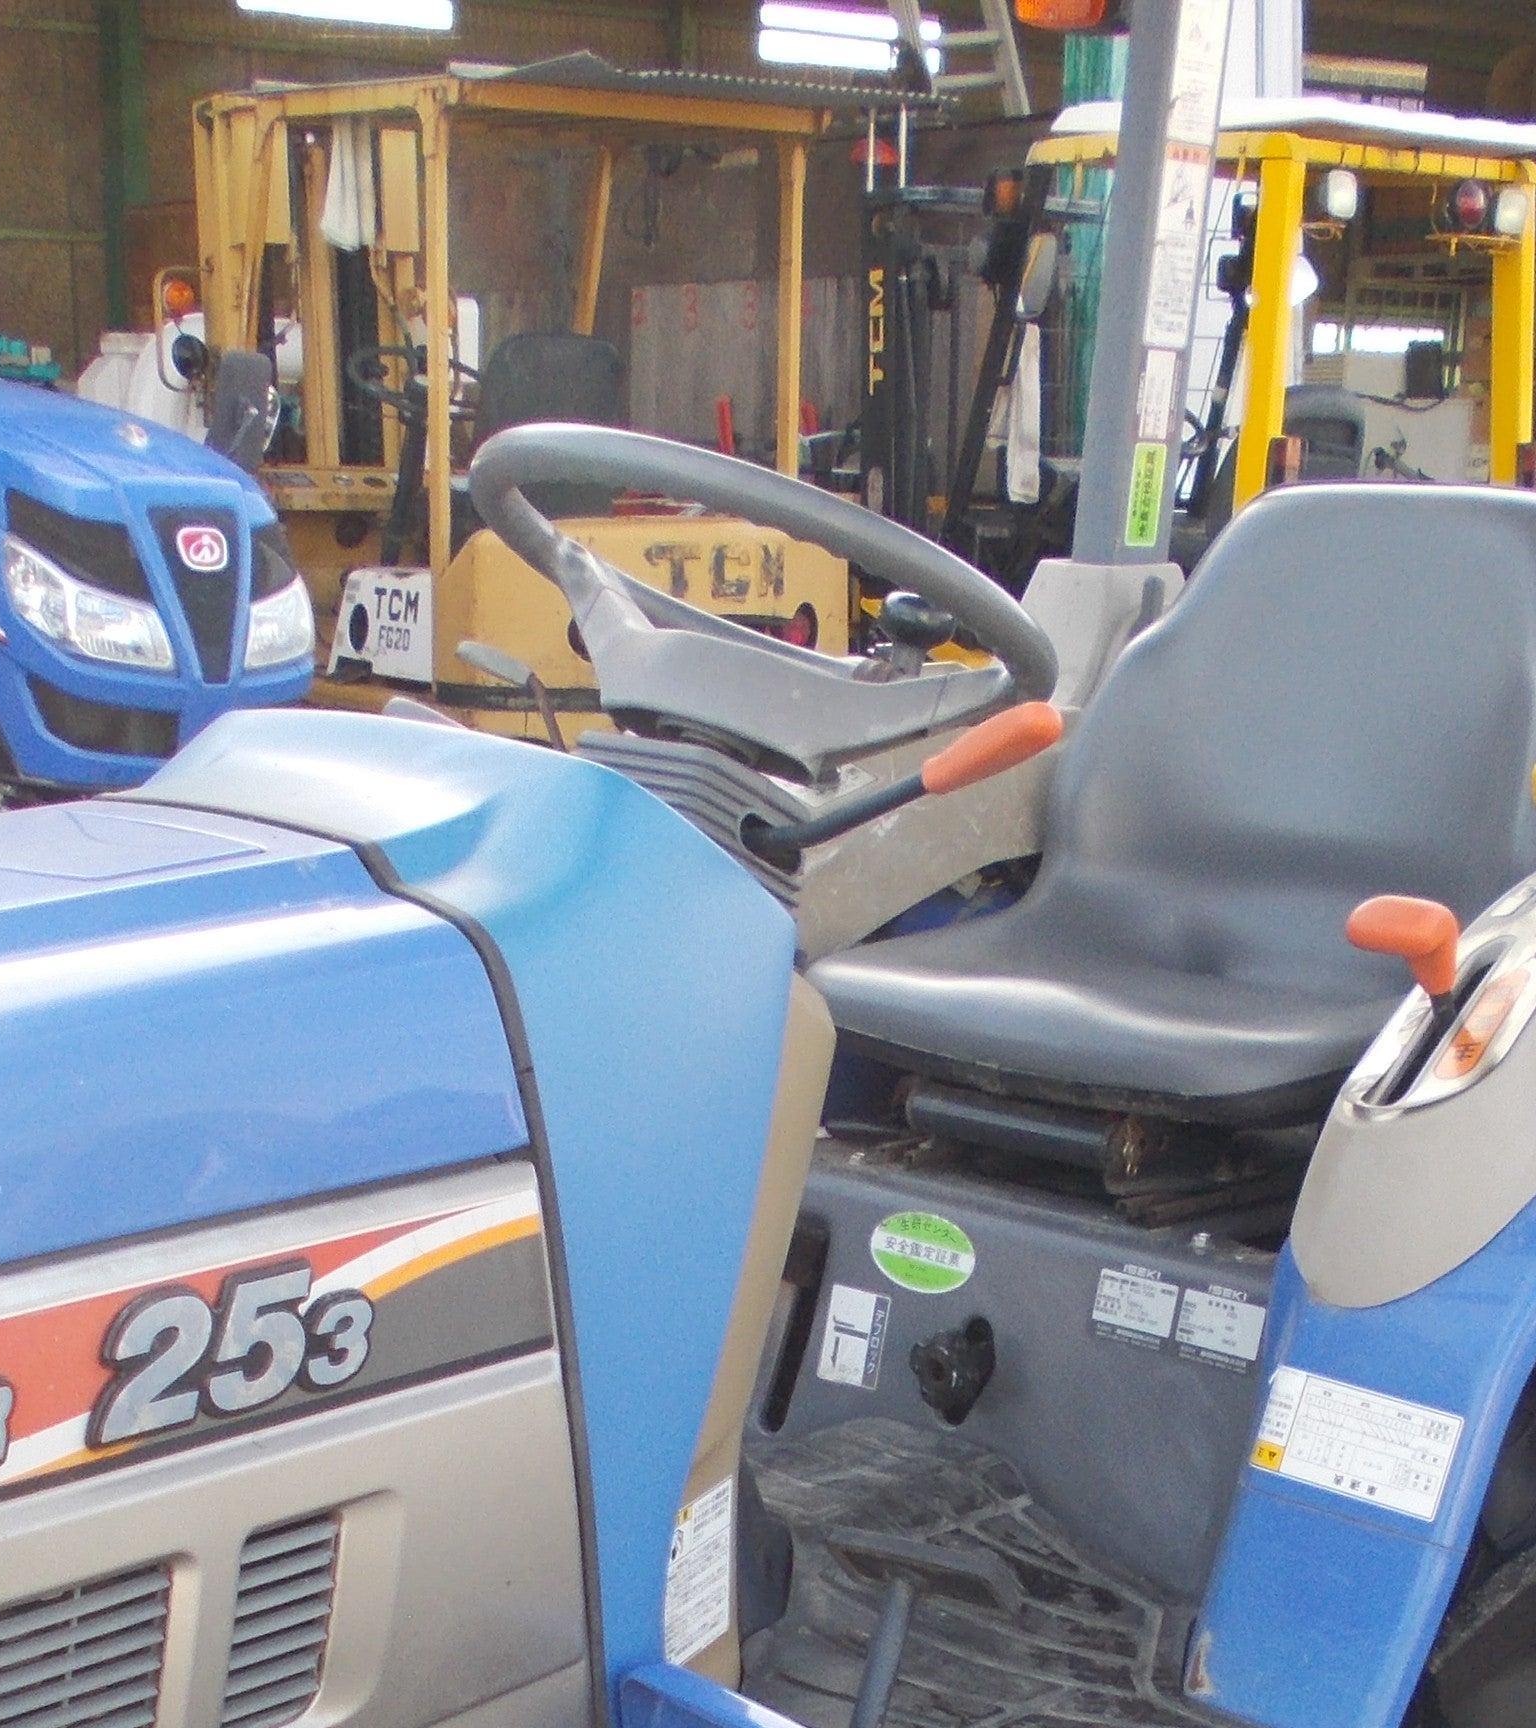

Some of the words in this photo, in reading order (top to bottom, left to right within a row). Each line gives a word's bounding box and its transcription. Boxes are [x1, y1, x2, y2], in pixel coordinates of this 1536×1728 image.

[868, 266, 884, 396] TCM
[374, 586, 420, 624] TCM
[378, 624, 411, 652] FG20
[1123, 1264, 1162, 1281] ISEKI
[1208, 1284, 1247, 1302] ISEKI
[866, 1309, 885, 1375] デフロック
